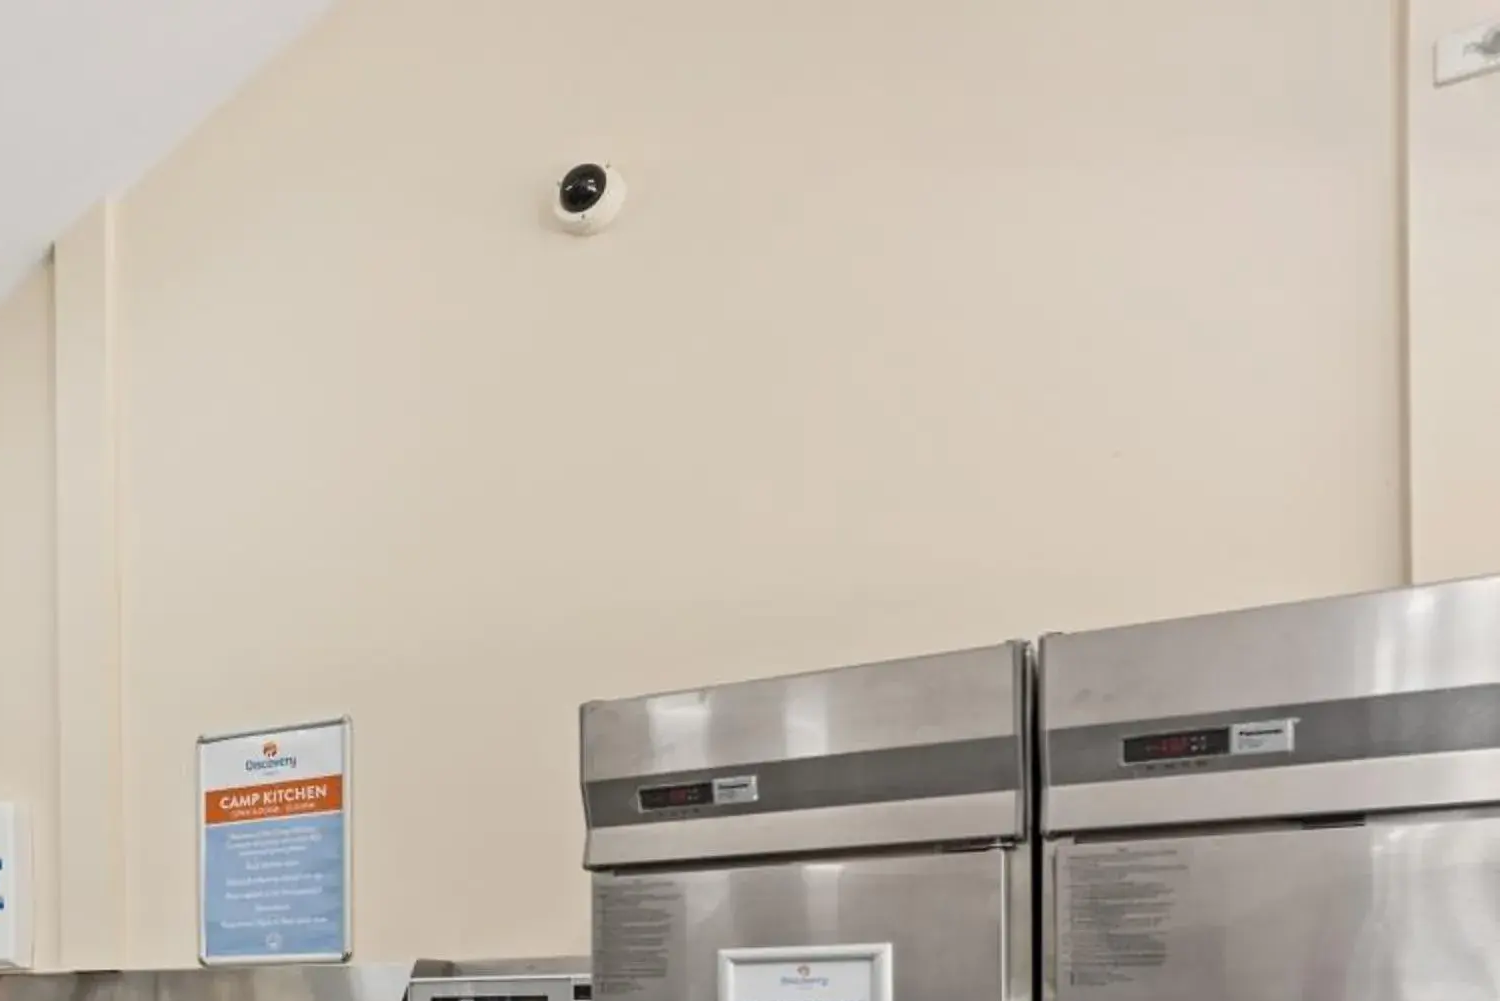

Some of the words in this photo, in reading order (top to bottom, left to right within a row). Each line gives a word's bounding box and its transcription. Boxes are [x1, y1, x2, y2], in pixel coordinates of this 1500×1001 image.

[245, 756, 297, 770] Discovery
[219, 792, 260, 809] CAMP
[263, 784, 327, 804] KITCHEN
